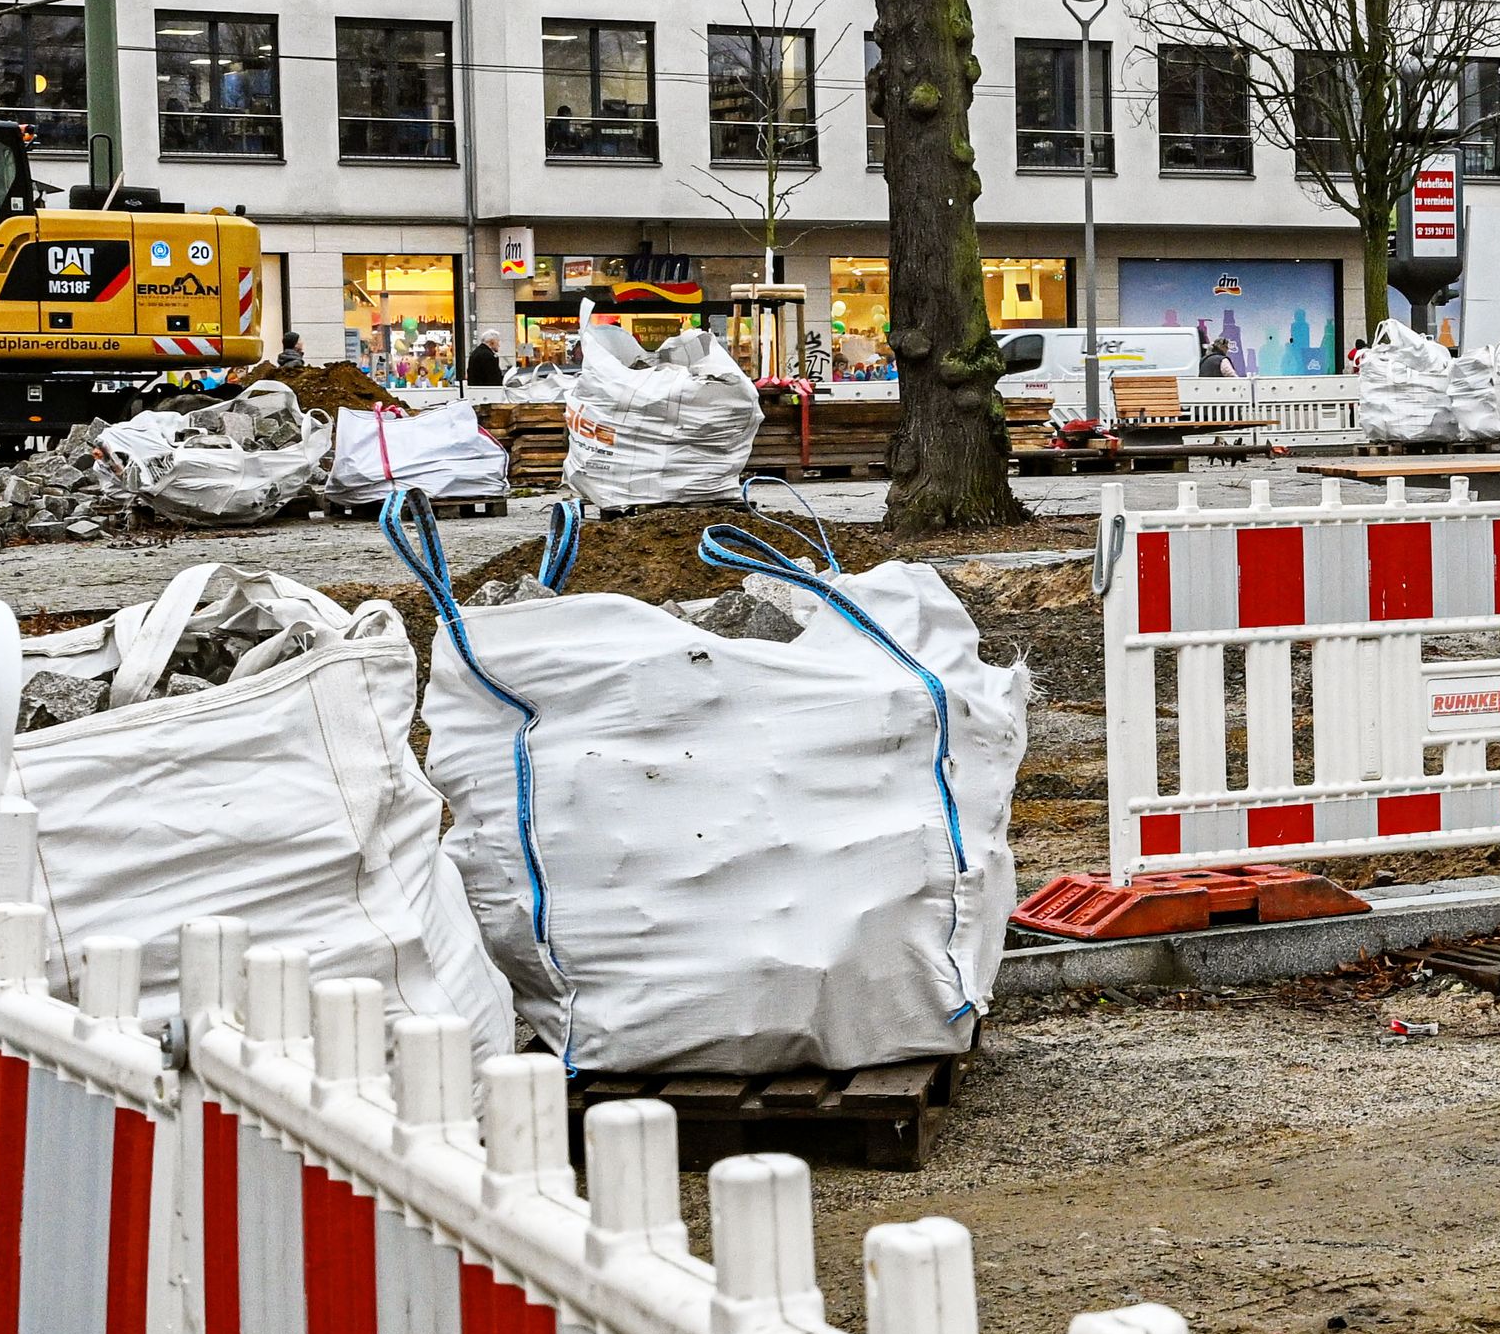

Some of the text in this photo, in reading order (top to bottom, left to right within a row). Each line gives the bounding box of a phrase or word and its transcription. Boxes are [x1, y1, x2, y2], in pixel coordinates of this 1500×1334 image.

[191, 245, 210, 260] 20
[504, 236, 522, 260] dm
[47, 247, 95, 275] CAT
[626, 240, 691, 282] dm
[48, 280, 92, 295] M318F
[1218, 274, 1238, 288] dm
[136, 283, 220, 296] ERDPLAN
[1433, 693, 1498, 711] RUHNKE
